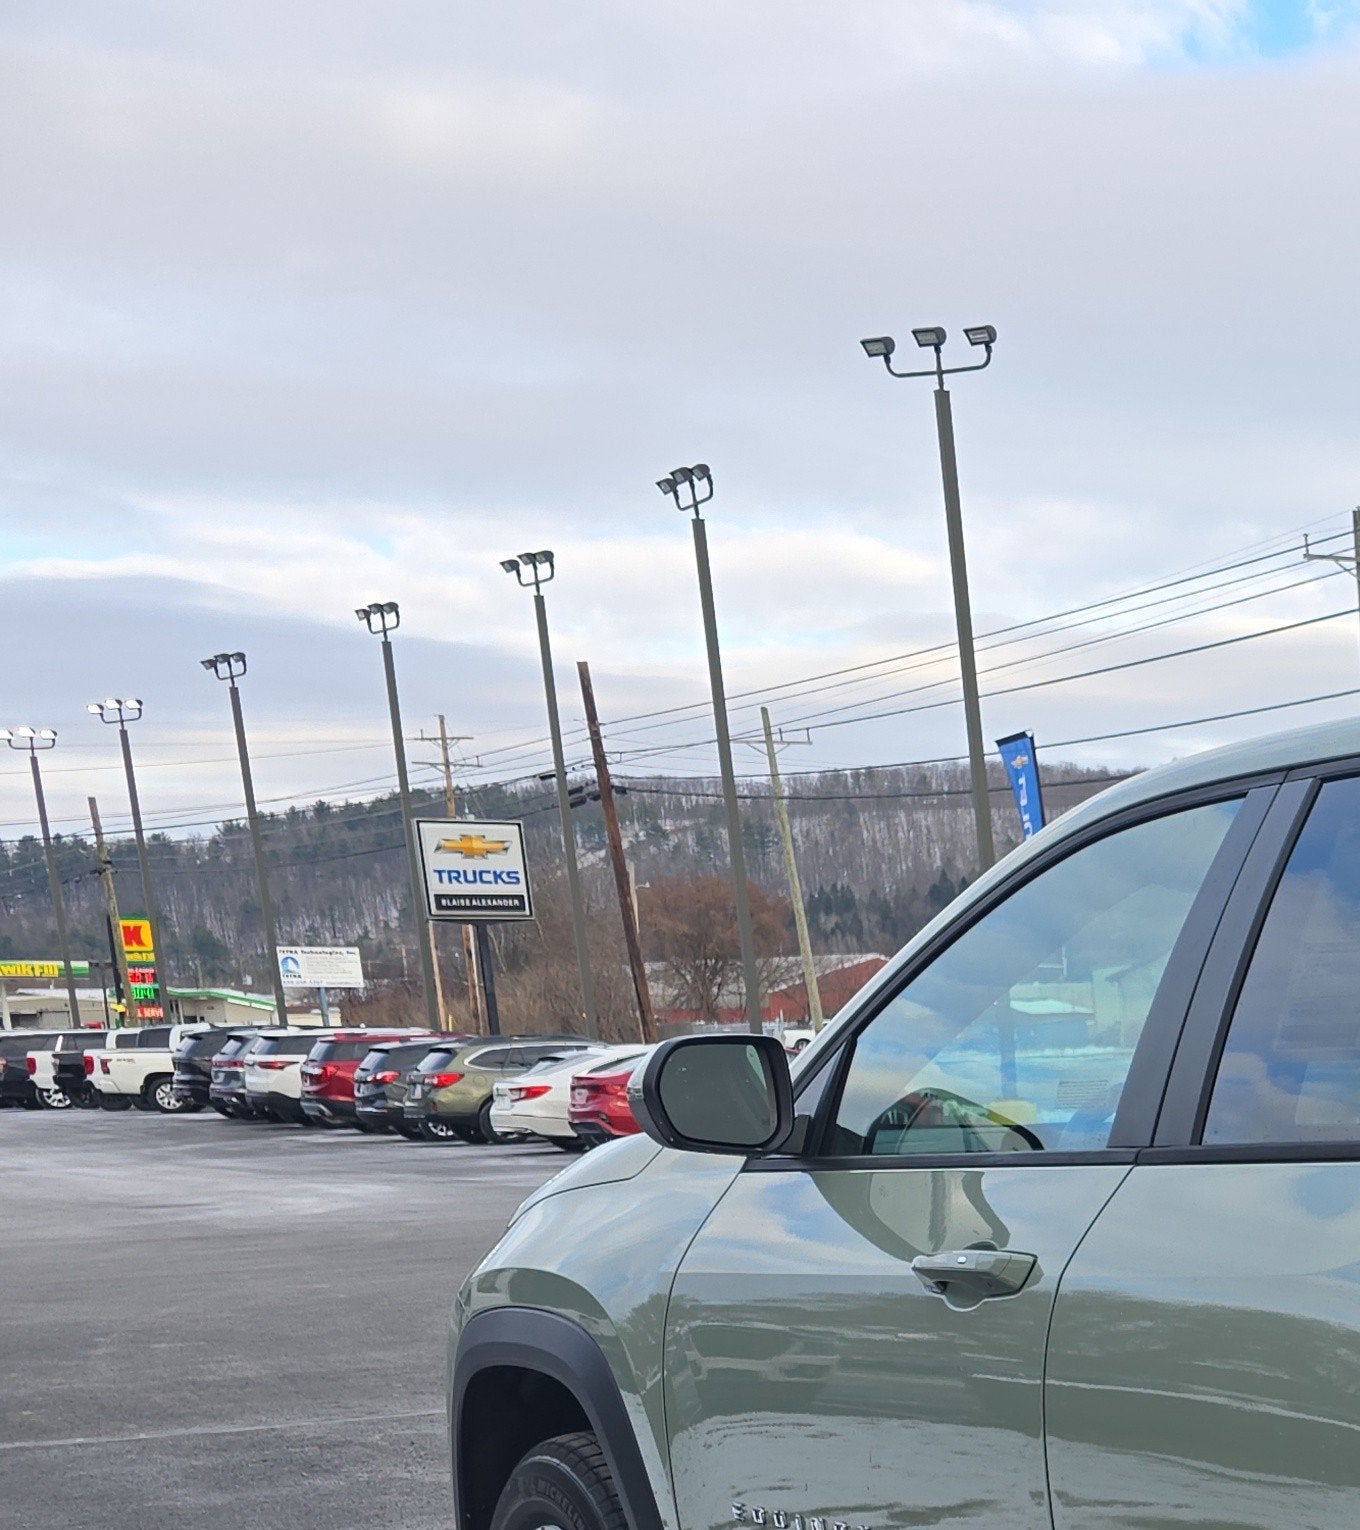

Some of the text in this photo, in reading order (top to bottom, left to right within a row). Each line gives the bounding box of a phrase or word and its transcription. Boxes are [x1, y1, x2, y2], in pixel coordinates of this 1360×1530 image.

[433, 869, 521, 885] TRUCKS
[441, 898, 520, 907] BLAISE ALEXANDER
